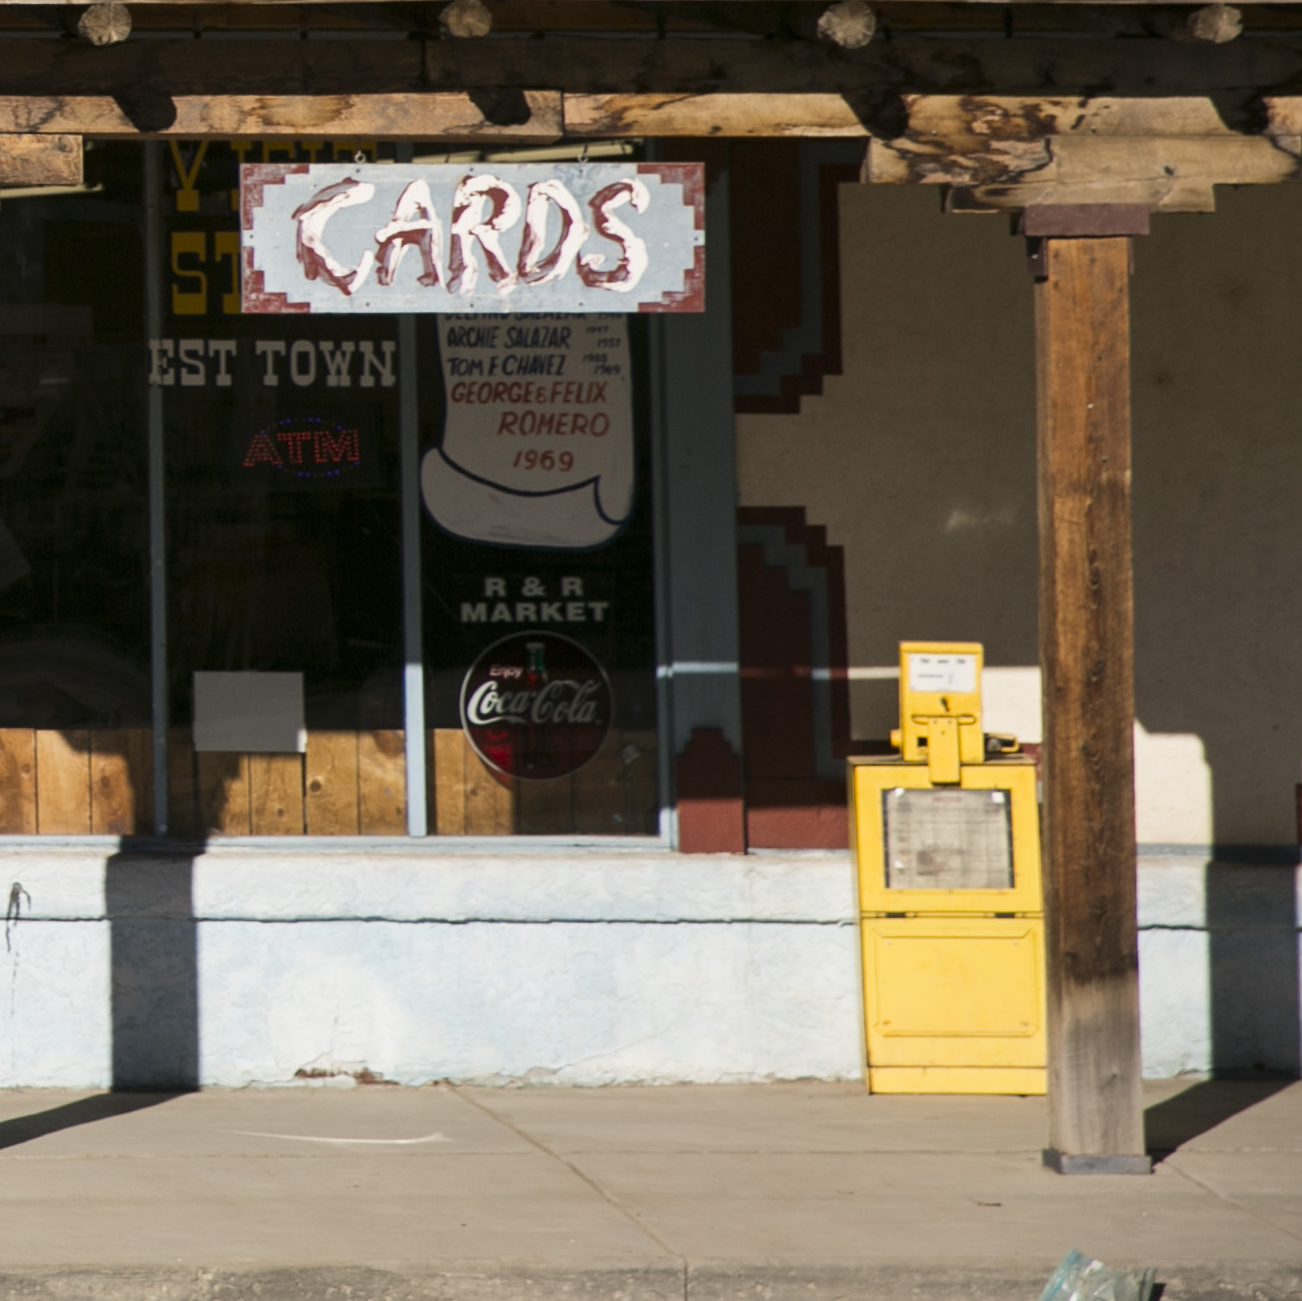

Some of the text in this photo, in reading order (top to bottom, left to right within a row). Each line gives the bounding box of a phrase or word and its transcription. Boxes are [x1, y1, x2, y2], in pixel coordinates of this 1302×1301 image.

[293, 173, 651, 296] CARDS
[447, 325, 500, 349] ARCHIE
[504, 325, 572, 350] SALAZAR
[149, 339, 397, 388] EST TOWN
[447, 356, 484, 377] TOM
[502, 353, 567, 377] CHAVEZ
[497, 410, 610, 437] ROMERO
[243, 429, 361, 468] ATM
[512, 450, 575, 472] 1969
[483, 576, 584, 597] R & R
[460, 601, 610, 623] MARKET
[489, 664, 524, 679] Enjoy
[467, 679, 603, 726] Coca-Cola
